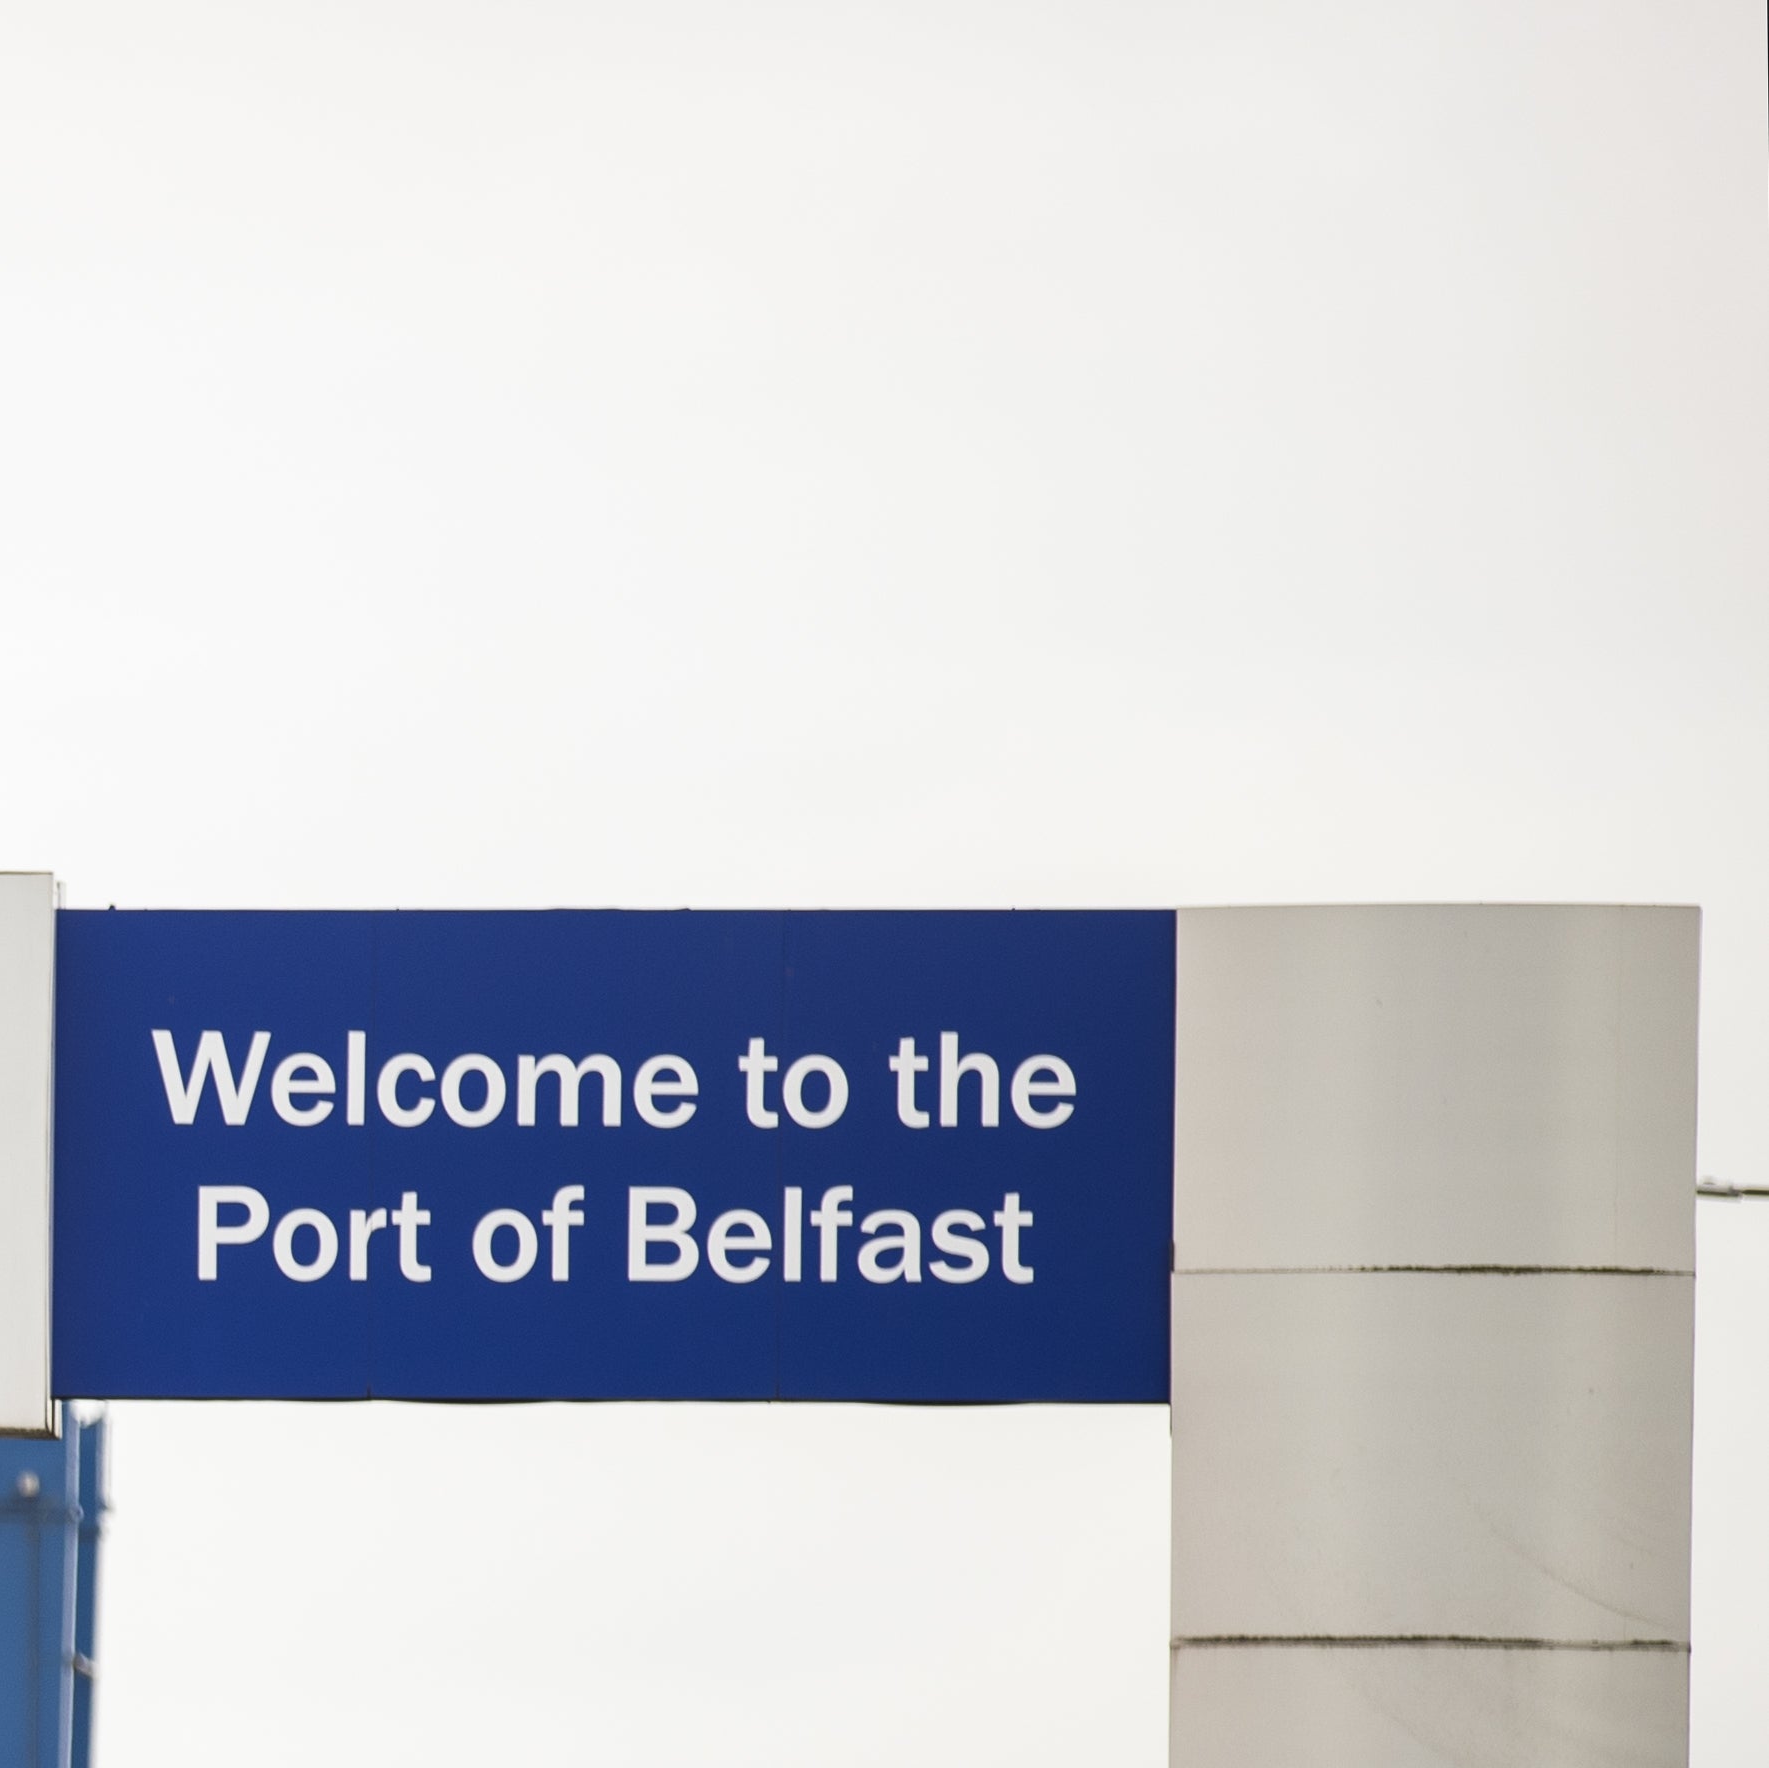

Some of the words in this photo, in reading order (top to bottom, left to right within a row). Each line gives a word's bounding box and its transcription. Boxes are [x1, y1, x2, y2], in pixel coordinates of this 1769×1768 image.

[151, 1029, 699, 1129] Welcome
[738, 1037, 849, 1129] to
[889, 1031, 1077, 1130] the
[197, 1185, 432, 1283] Port
[472, 1185, 585, 1283] of
[627, 1185, 1034, 1284] Belfast
